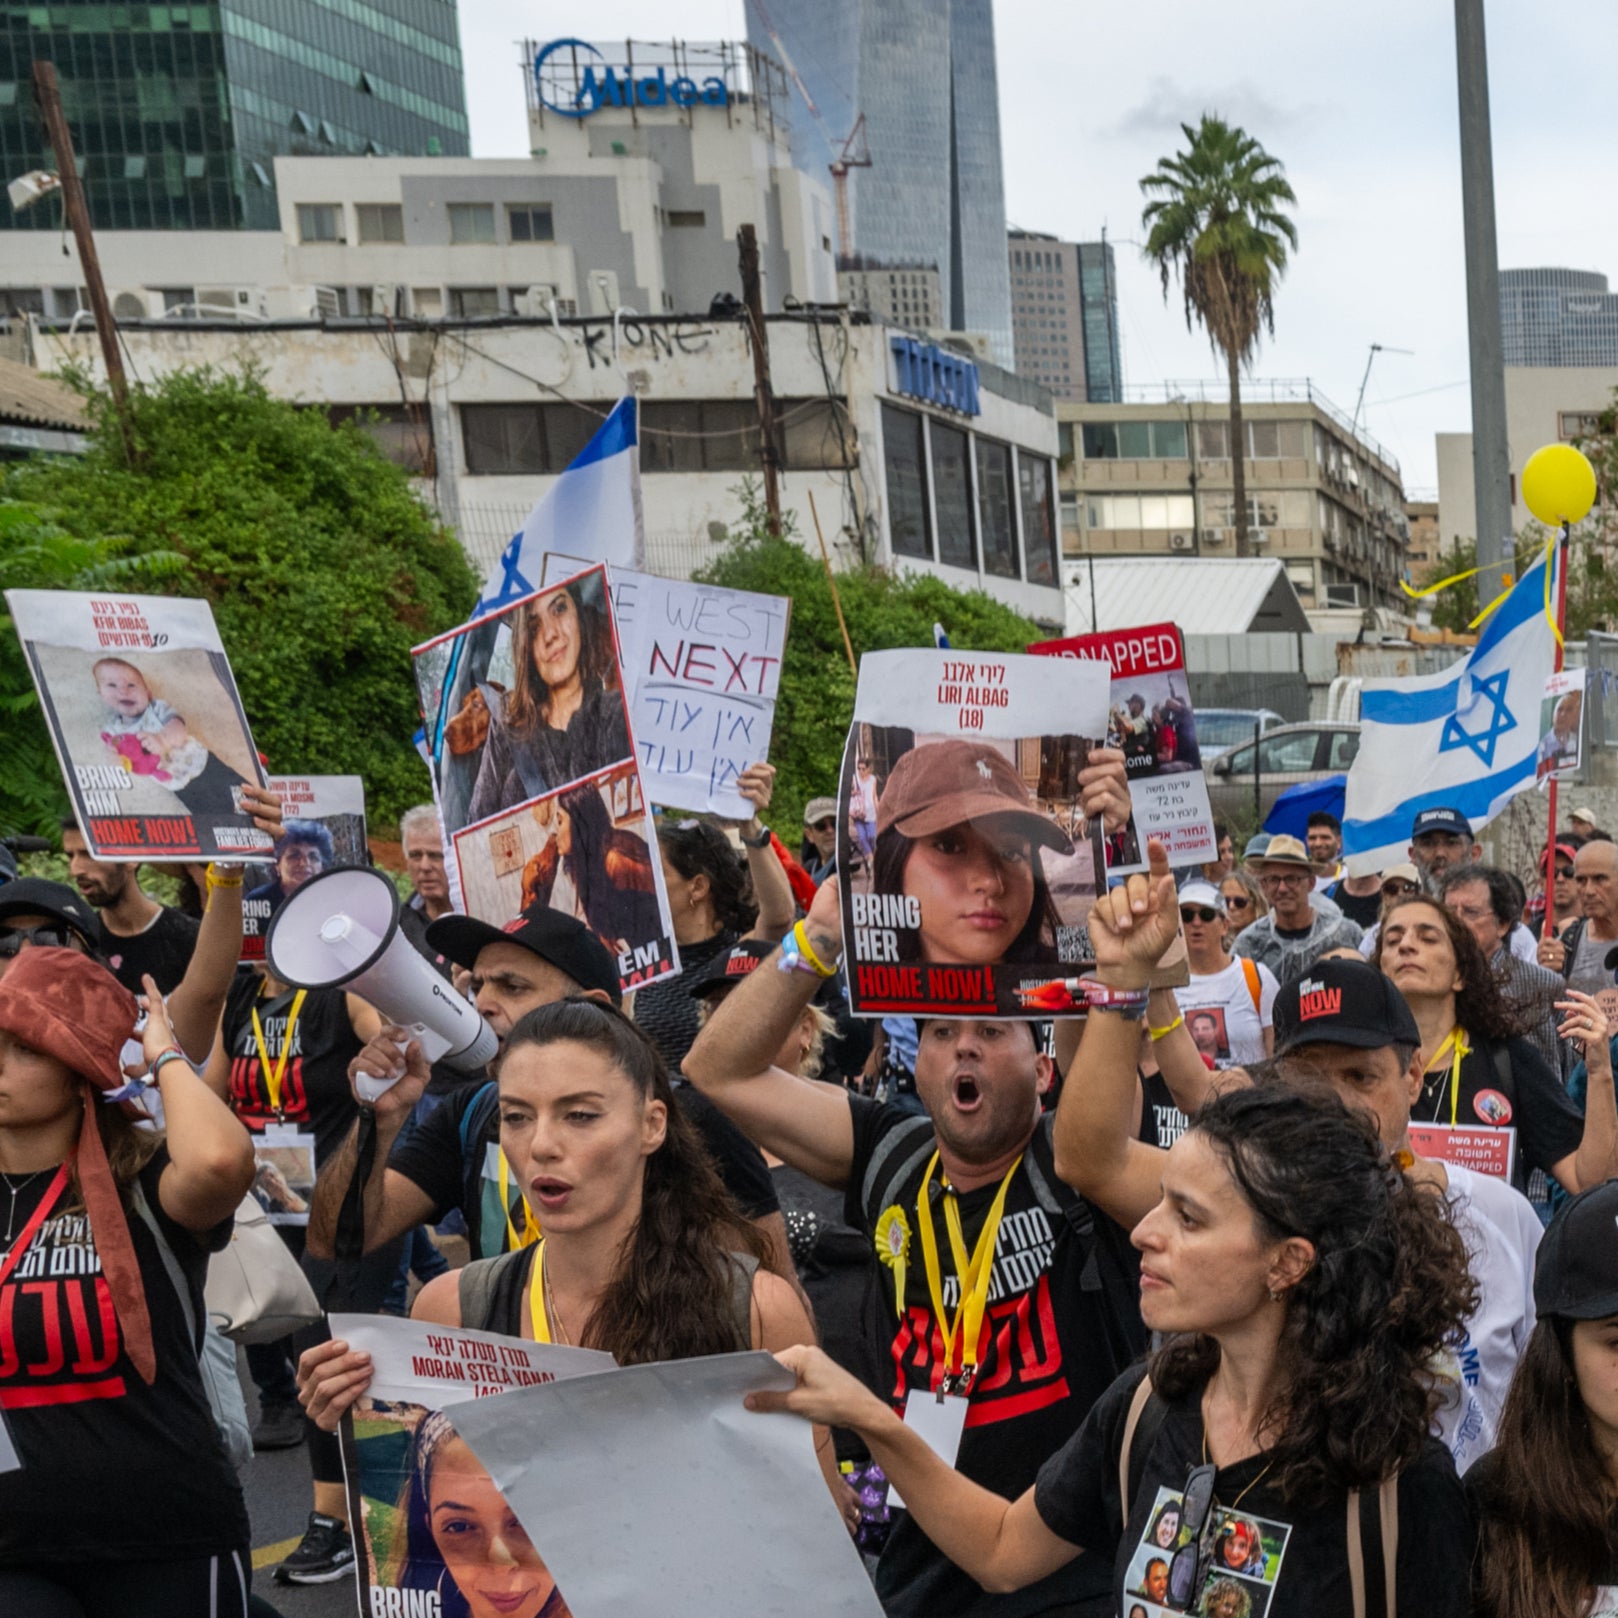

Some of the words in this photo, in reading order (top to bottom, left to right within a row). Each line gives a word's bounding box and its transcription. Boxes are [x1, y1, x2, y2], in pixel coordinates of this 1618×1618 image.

[577, 65, 727, 108] Midea
[93, 616, 117, 630] KFIR
[667, 591, 783, 651] WEST
[649, 640, 779, 694] NEXT
[980, 665, 1005, 685] לירי
[938, 686, 963, 705] LIRI
[965, 687, 1009, 708] ALBAG
[645, 698, 703, 732] עוד
[713, 690, 754, 750] אין
[959, 708, 984, 730] (18)
[639, 741, 693, 774] עוד
[75, 766, 133, 790] BRING
[82, 792, 122, 816] HIM
[284, 804, 299, 815] (72)
[1157, 797, 1169, 806] 72
[90, 817, 144, 845] HOME
[145, 816, 198, 845] NOW!
[852, 895, 921, 929] BRING
[854, 928, 899, 963] HER
[858, 966, 921, 999] HOME
[928, 966, 995, 1001] NOW!
[1300, 987, 1342, 1015] NOW
[412, 1356, 465, 1381] MORAN
[469, 1362, 513, 1385] STELA
